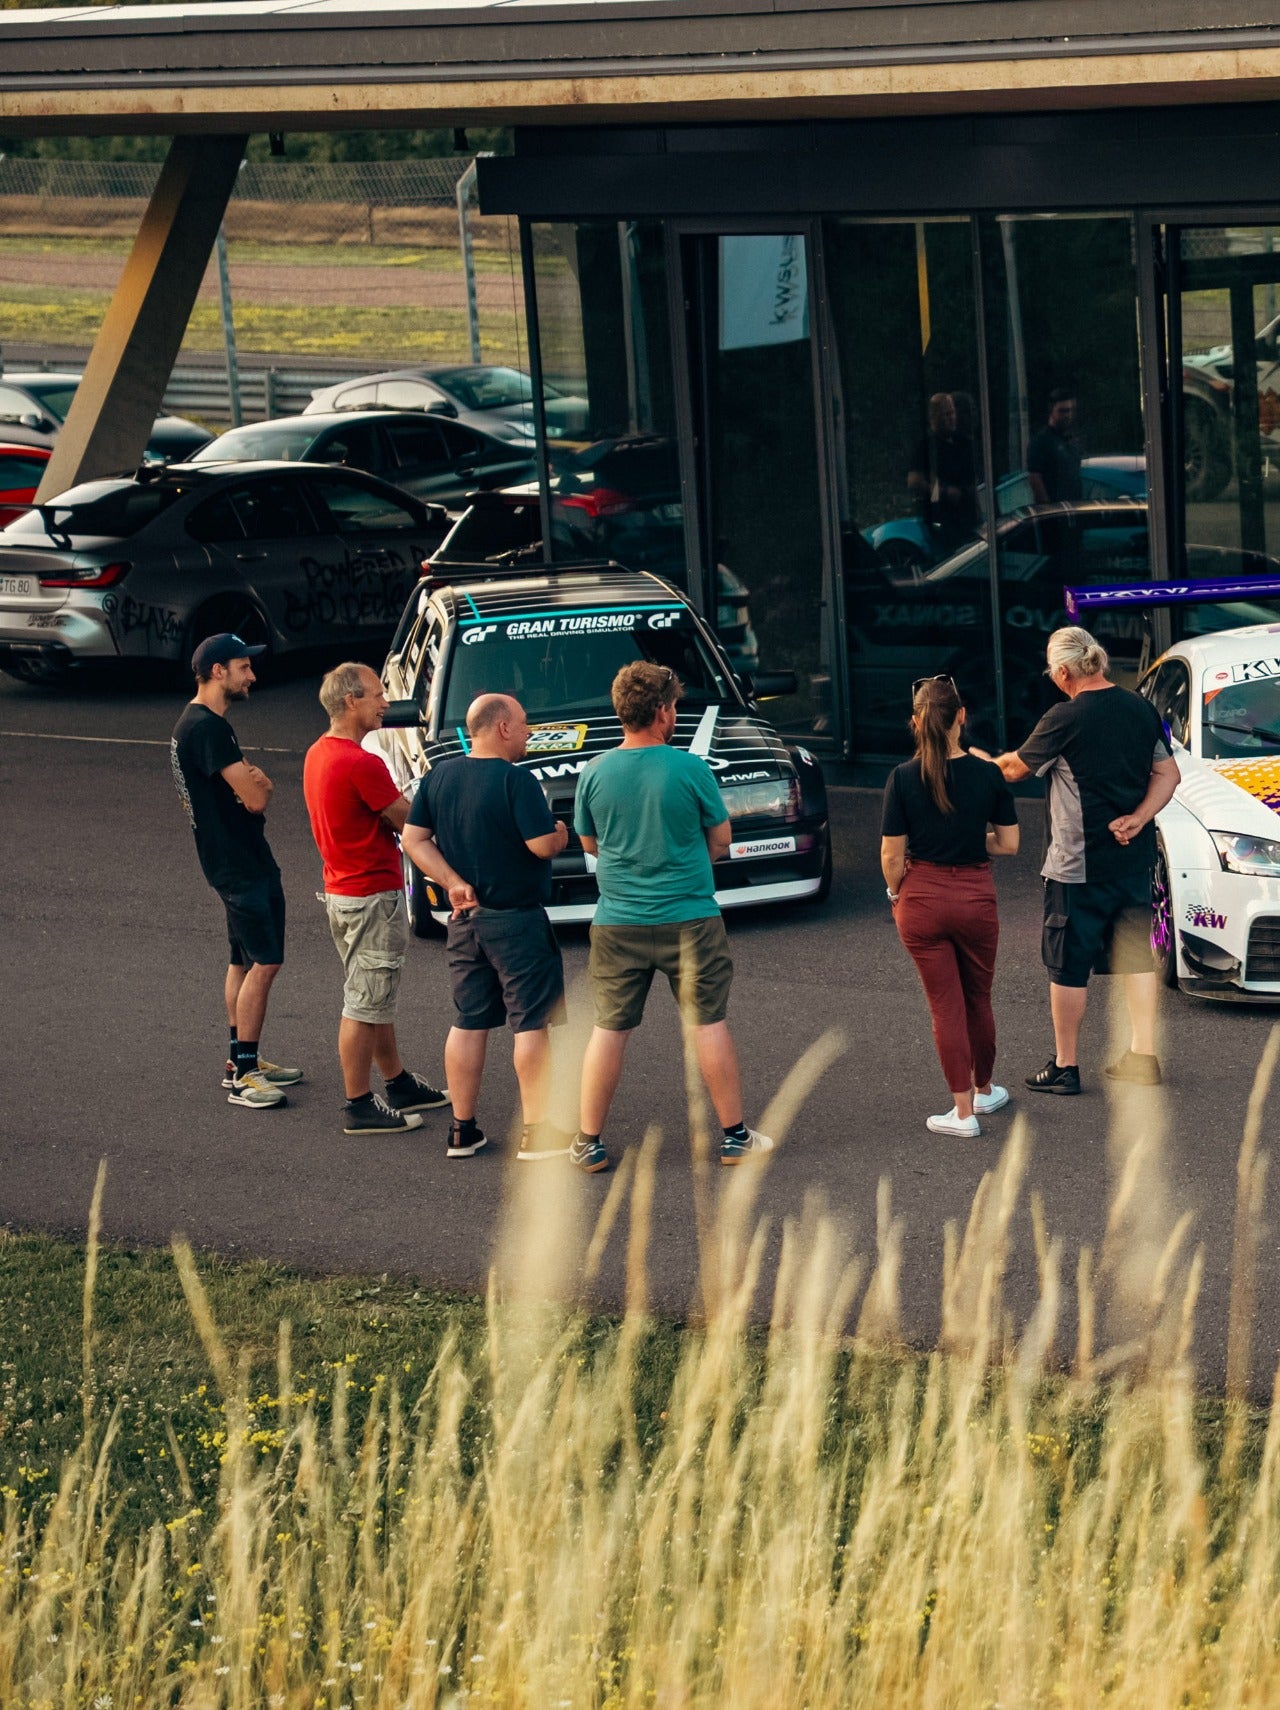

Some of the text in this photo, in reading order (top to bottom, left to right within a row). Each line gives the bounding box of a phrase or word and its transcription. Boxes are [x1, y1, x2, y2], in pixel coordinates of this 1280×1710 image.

[4, 579, 30, 594] TG 80
[506, 620, 556, 636] GRAN
[586, 626, 635, 634] SIMULATOR
[720, 771, 770, 783] HWA
[1193, 911, 1228, 930] KW
